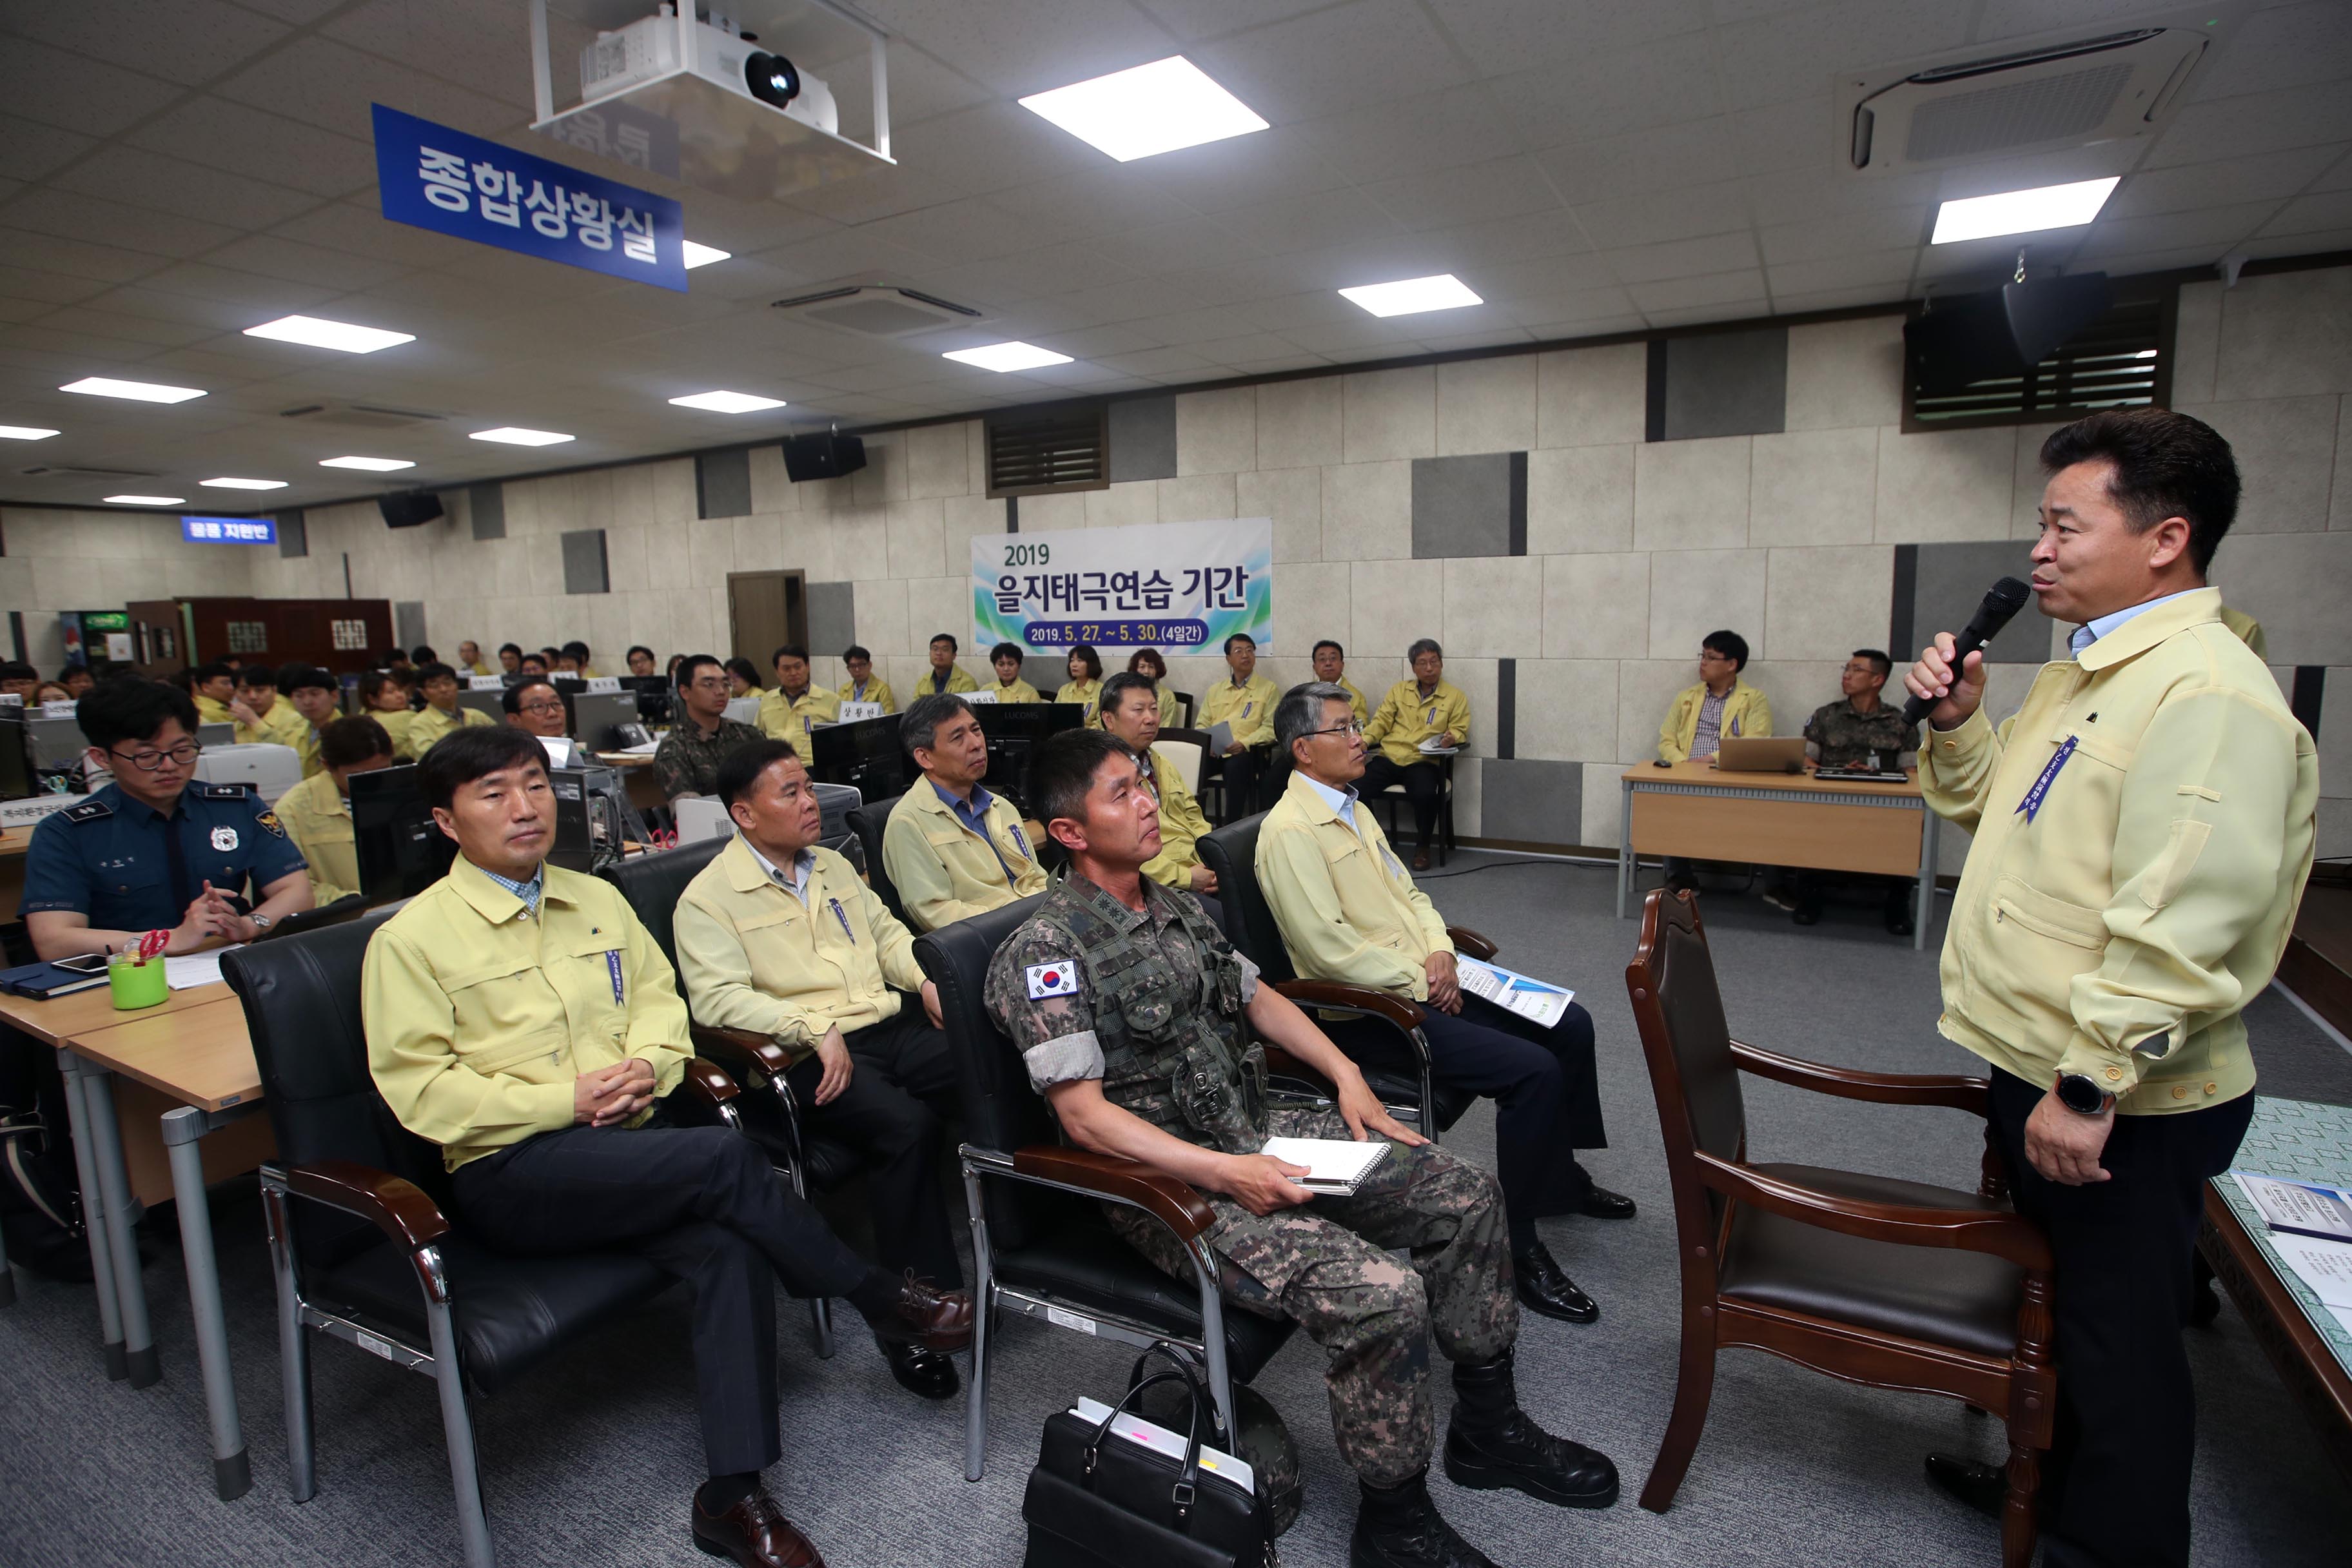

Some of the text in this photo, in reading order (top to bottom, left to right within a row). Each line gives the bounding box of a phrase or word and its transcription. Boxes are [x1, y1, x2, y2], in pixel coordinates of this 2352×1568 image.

[418, 145, 658, 265] 종합상황실
[1004, 543, 1050, 567] 2019
[994, 565, 1249, 613] 을지태극연습 기간
[1032, 628, 1061, 642] 2019.
[1082, 625, 1101, 642] 27.
